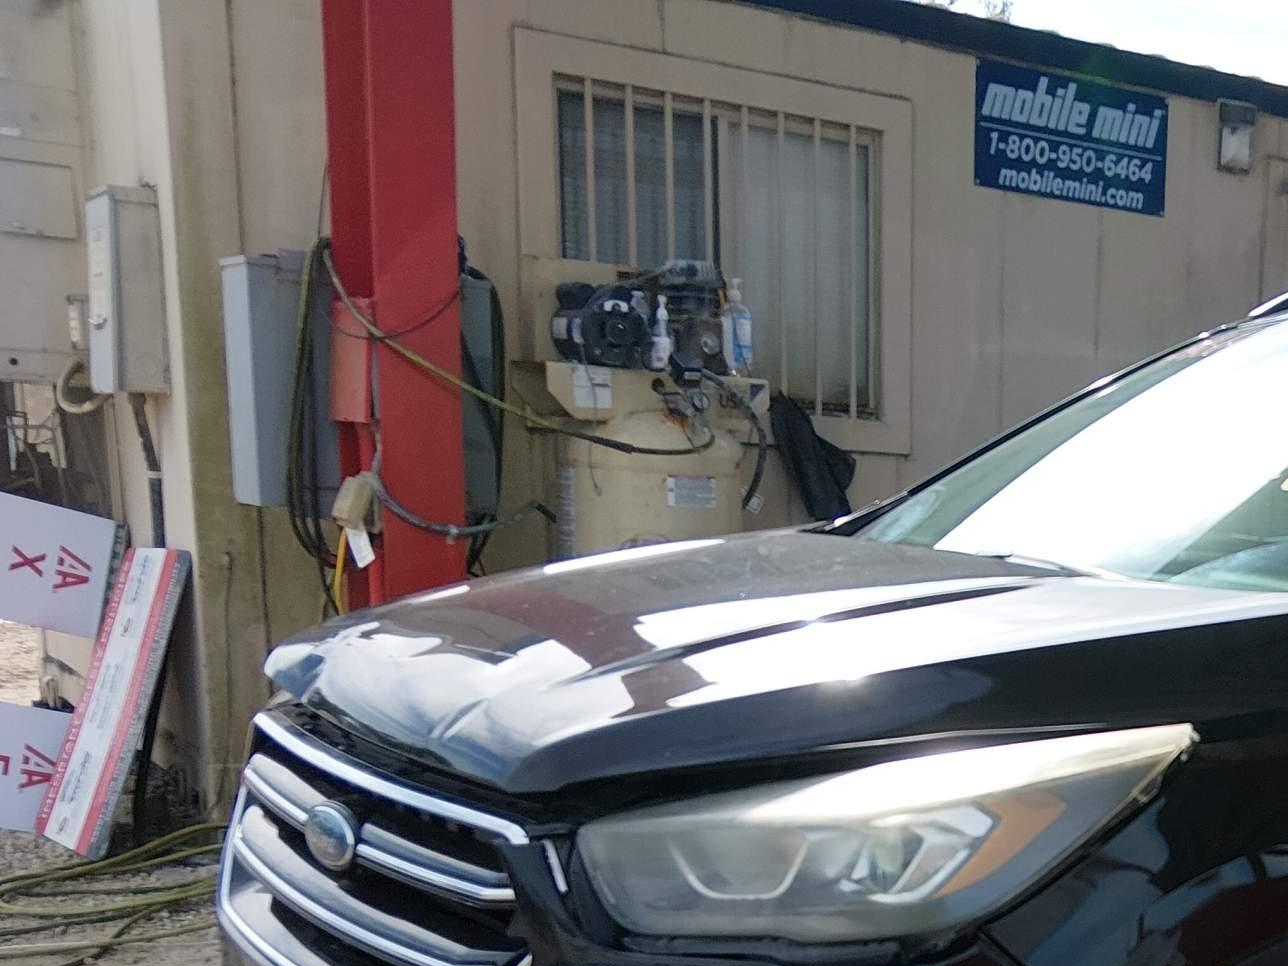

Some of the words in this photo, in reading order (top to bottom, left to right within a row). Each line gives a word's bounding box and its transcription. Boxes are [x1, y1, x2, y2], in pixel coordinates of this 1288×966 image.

[982, 76, 1090, 135] mobile
[1092, 102, 1163, 149] mini
[989, 131, 1153, 184] 1-800-950-6464
[999, 168, 1144, 209] mobilemini.com
